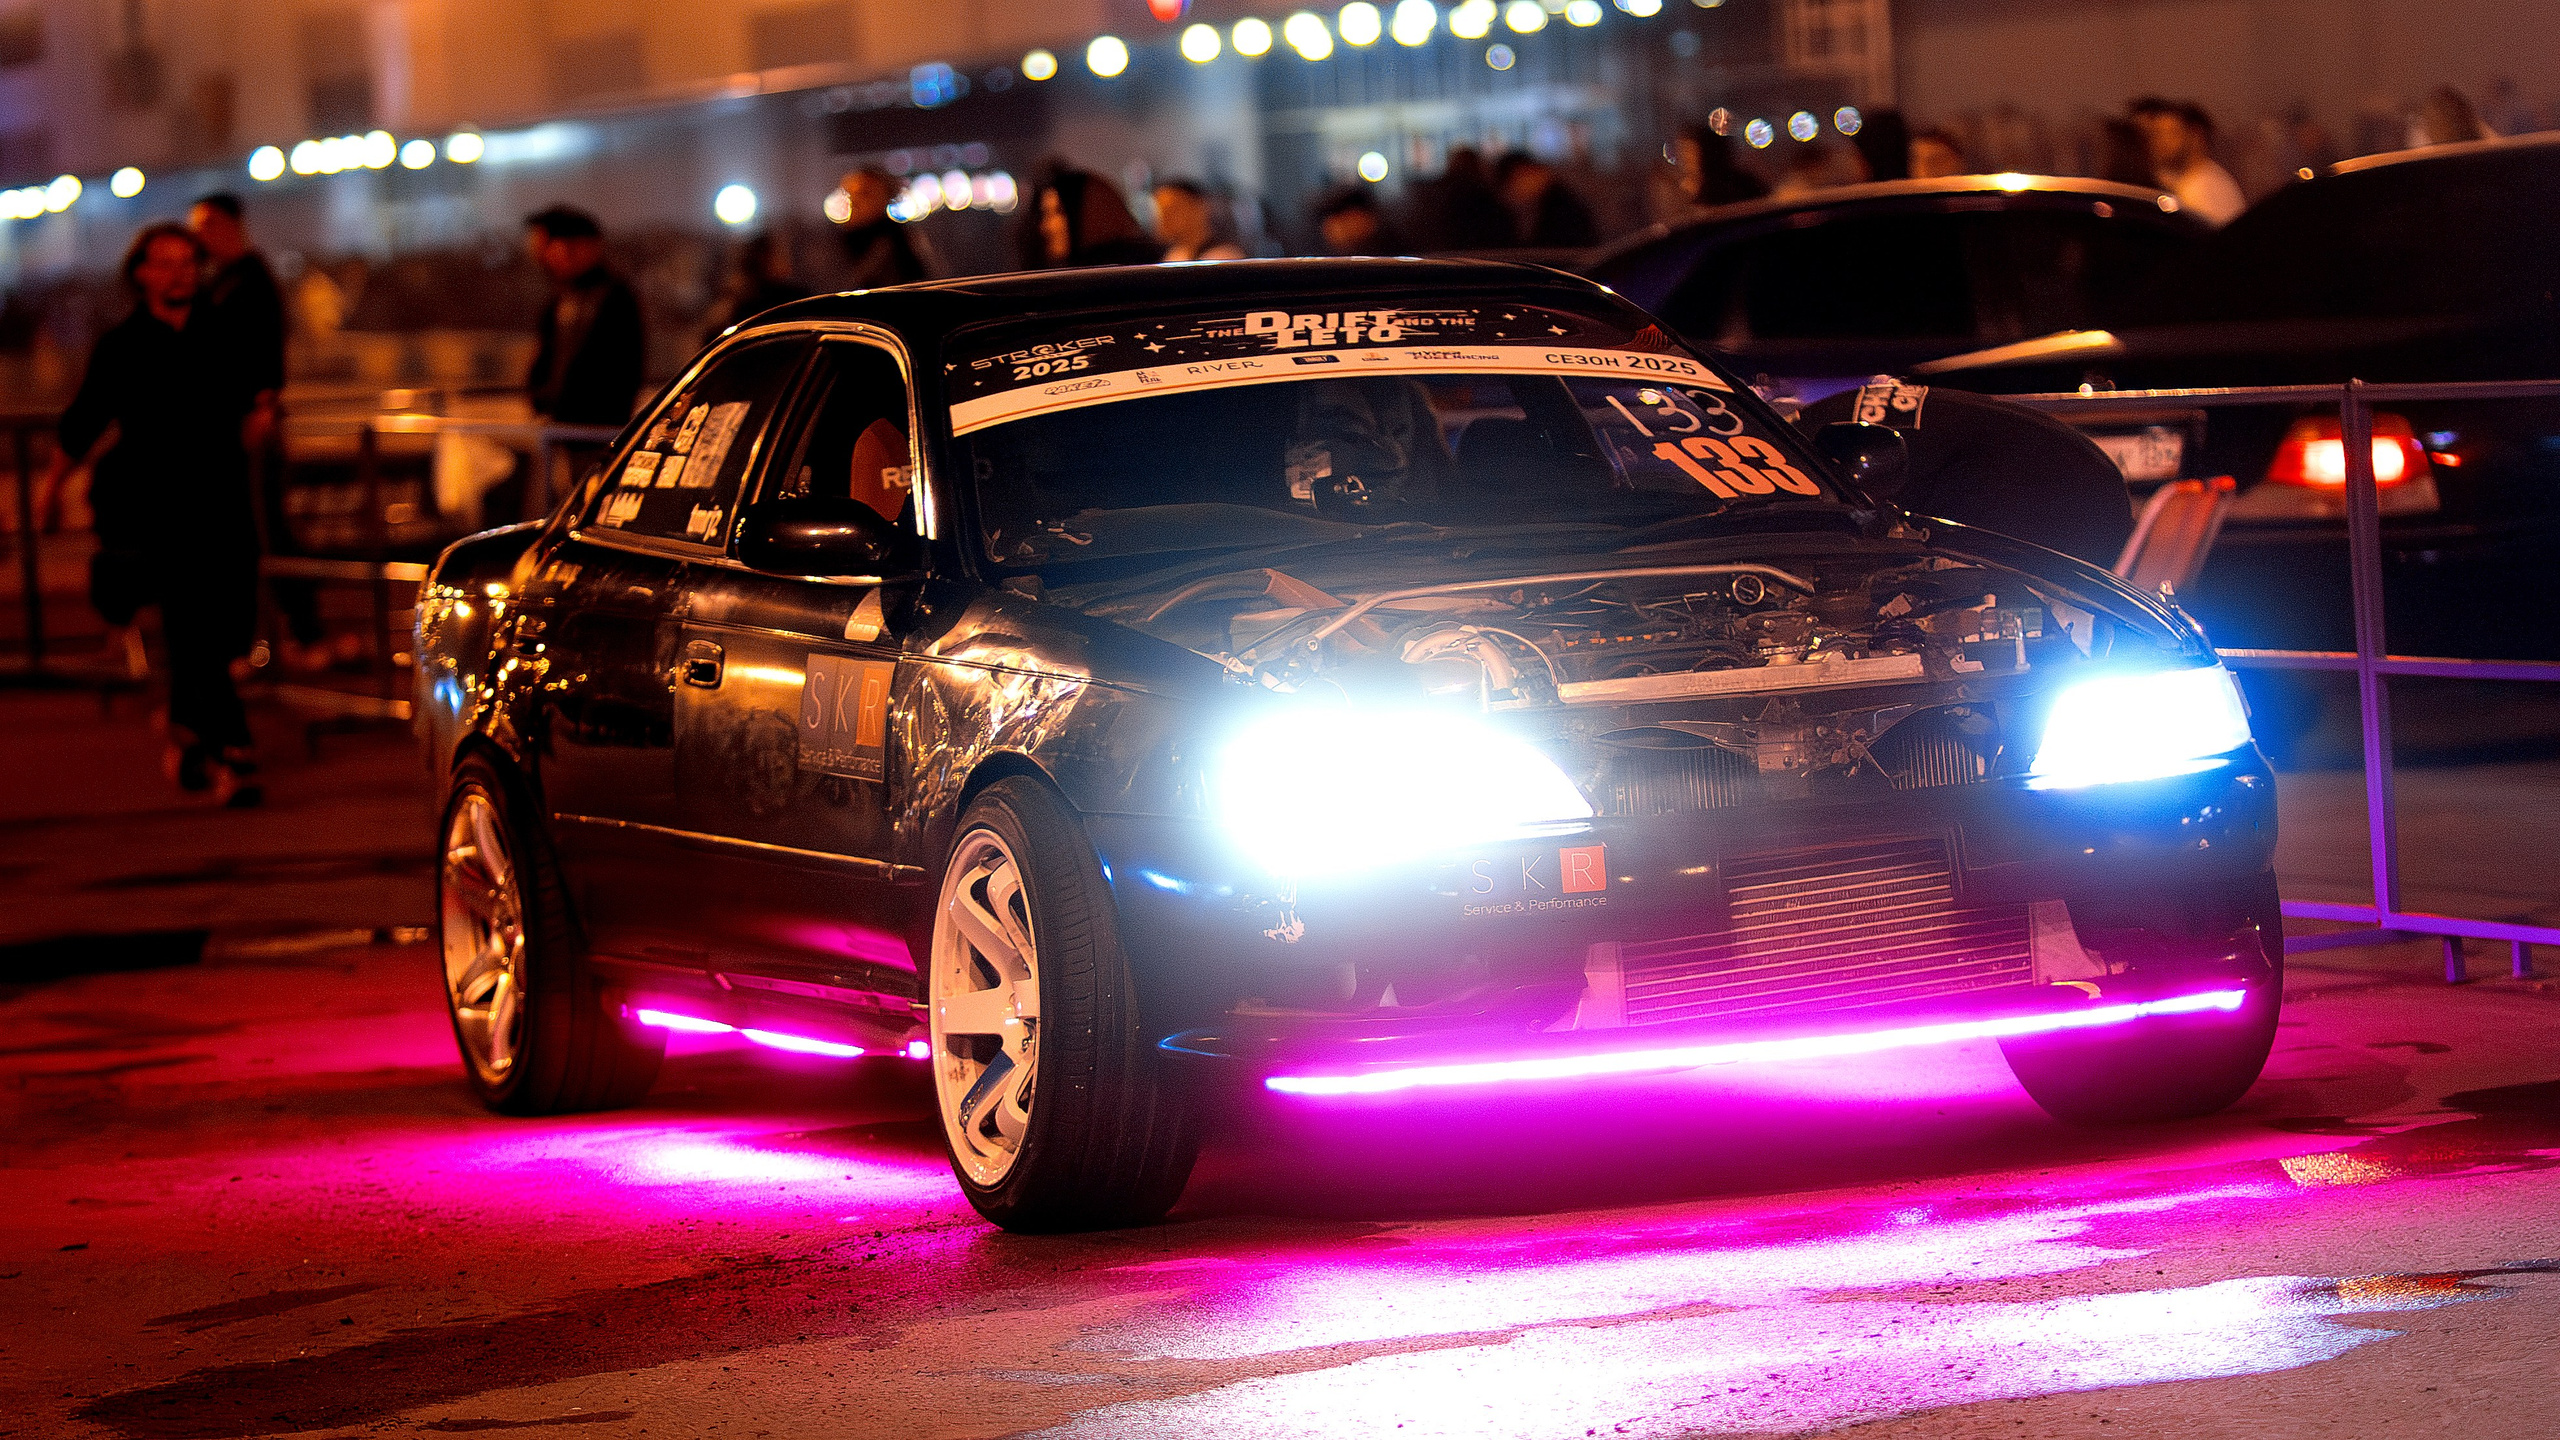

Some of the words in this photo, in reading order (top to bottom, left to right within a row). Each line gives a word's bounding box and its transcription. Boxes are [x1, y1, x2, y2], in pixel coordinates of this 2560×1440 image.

[1206, 328, 1244, 338] THE
[1245, 311, 1396, 335] DRIFT
[1277, 326, 1401, 348] LETO
[1013, 355, 1090, 380] 2025
[1187, 360, 1263, 375] RIVER
[1545, 353, 1620, 368] СЕЗОН
[1626, 355, 1697, 376] 2025
[1605, 388, 1744, 437] 133
[1652, 435, 1821, 499] 133
[807, 671, 880, 735] SKR
[1471, 853, 1596, 894] SKR
[1464, 903, 1511, 916] Service
[1514, 900, 1525, 912] &
